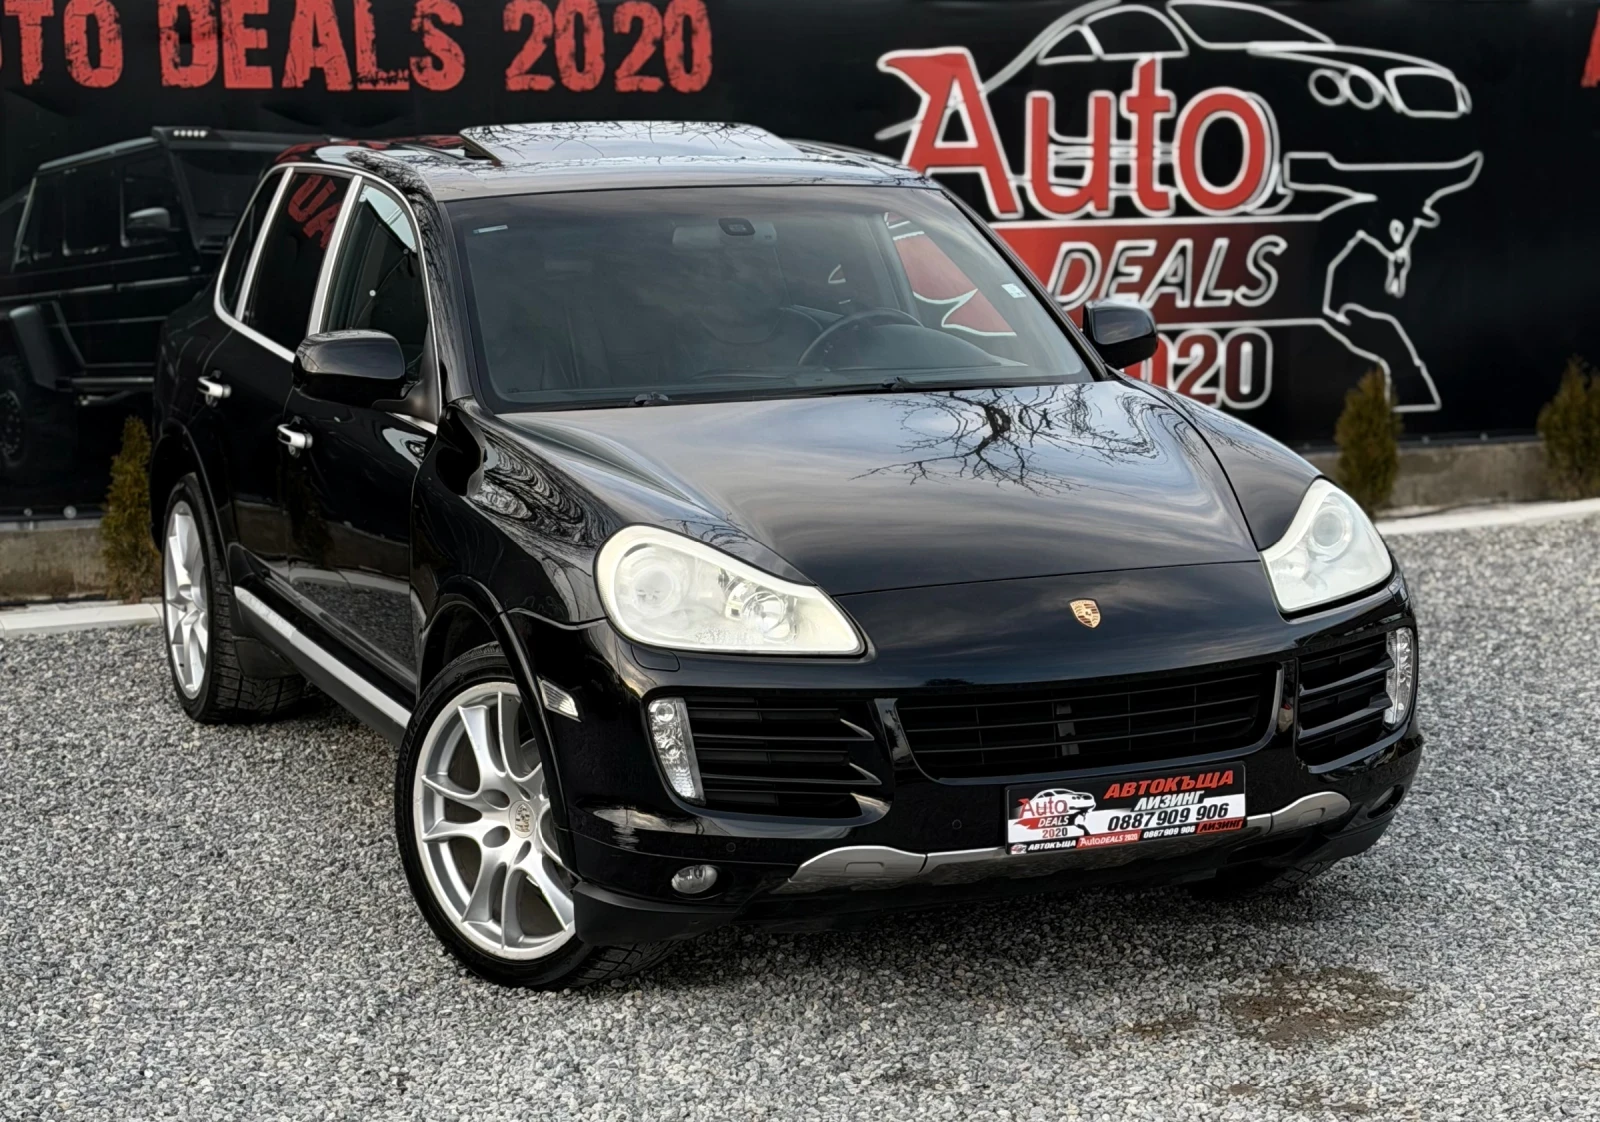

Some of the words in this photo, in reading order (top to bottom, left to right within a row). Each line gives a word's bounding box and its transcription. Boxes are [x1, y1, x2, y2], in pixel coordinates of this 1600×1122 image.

[0, 0, 123, 88] TO
[157, 0, 467, 91] DEALS
[503, 0, 714, 93] 2020
[877, 46, 1272, 219] Auto
[1044, 236, 1287, 311] DEALS
[1103, 770, 1234, 800] АВТОКЪЩА
[1018, 796, 1069, 819] Auto
[1133, 790, 1205, 812] ЛИЗИНГ
[1195, 802, 1230, 821] 906
[1037, 815, 1070, 828] DEALS
[1042, 827, 1068, 839] 2020
[1027, 839, 1077, 852] АВТОКЪЩА
[1200, 819, 1243, 832] ЛИЗИНГ
